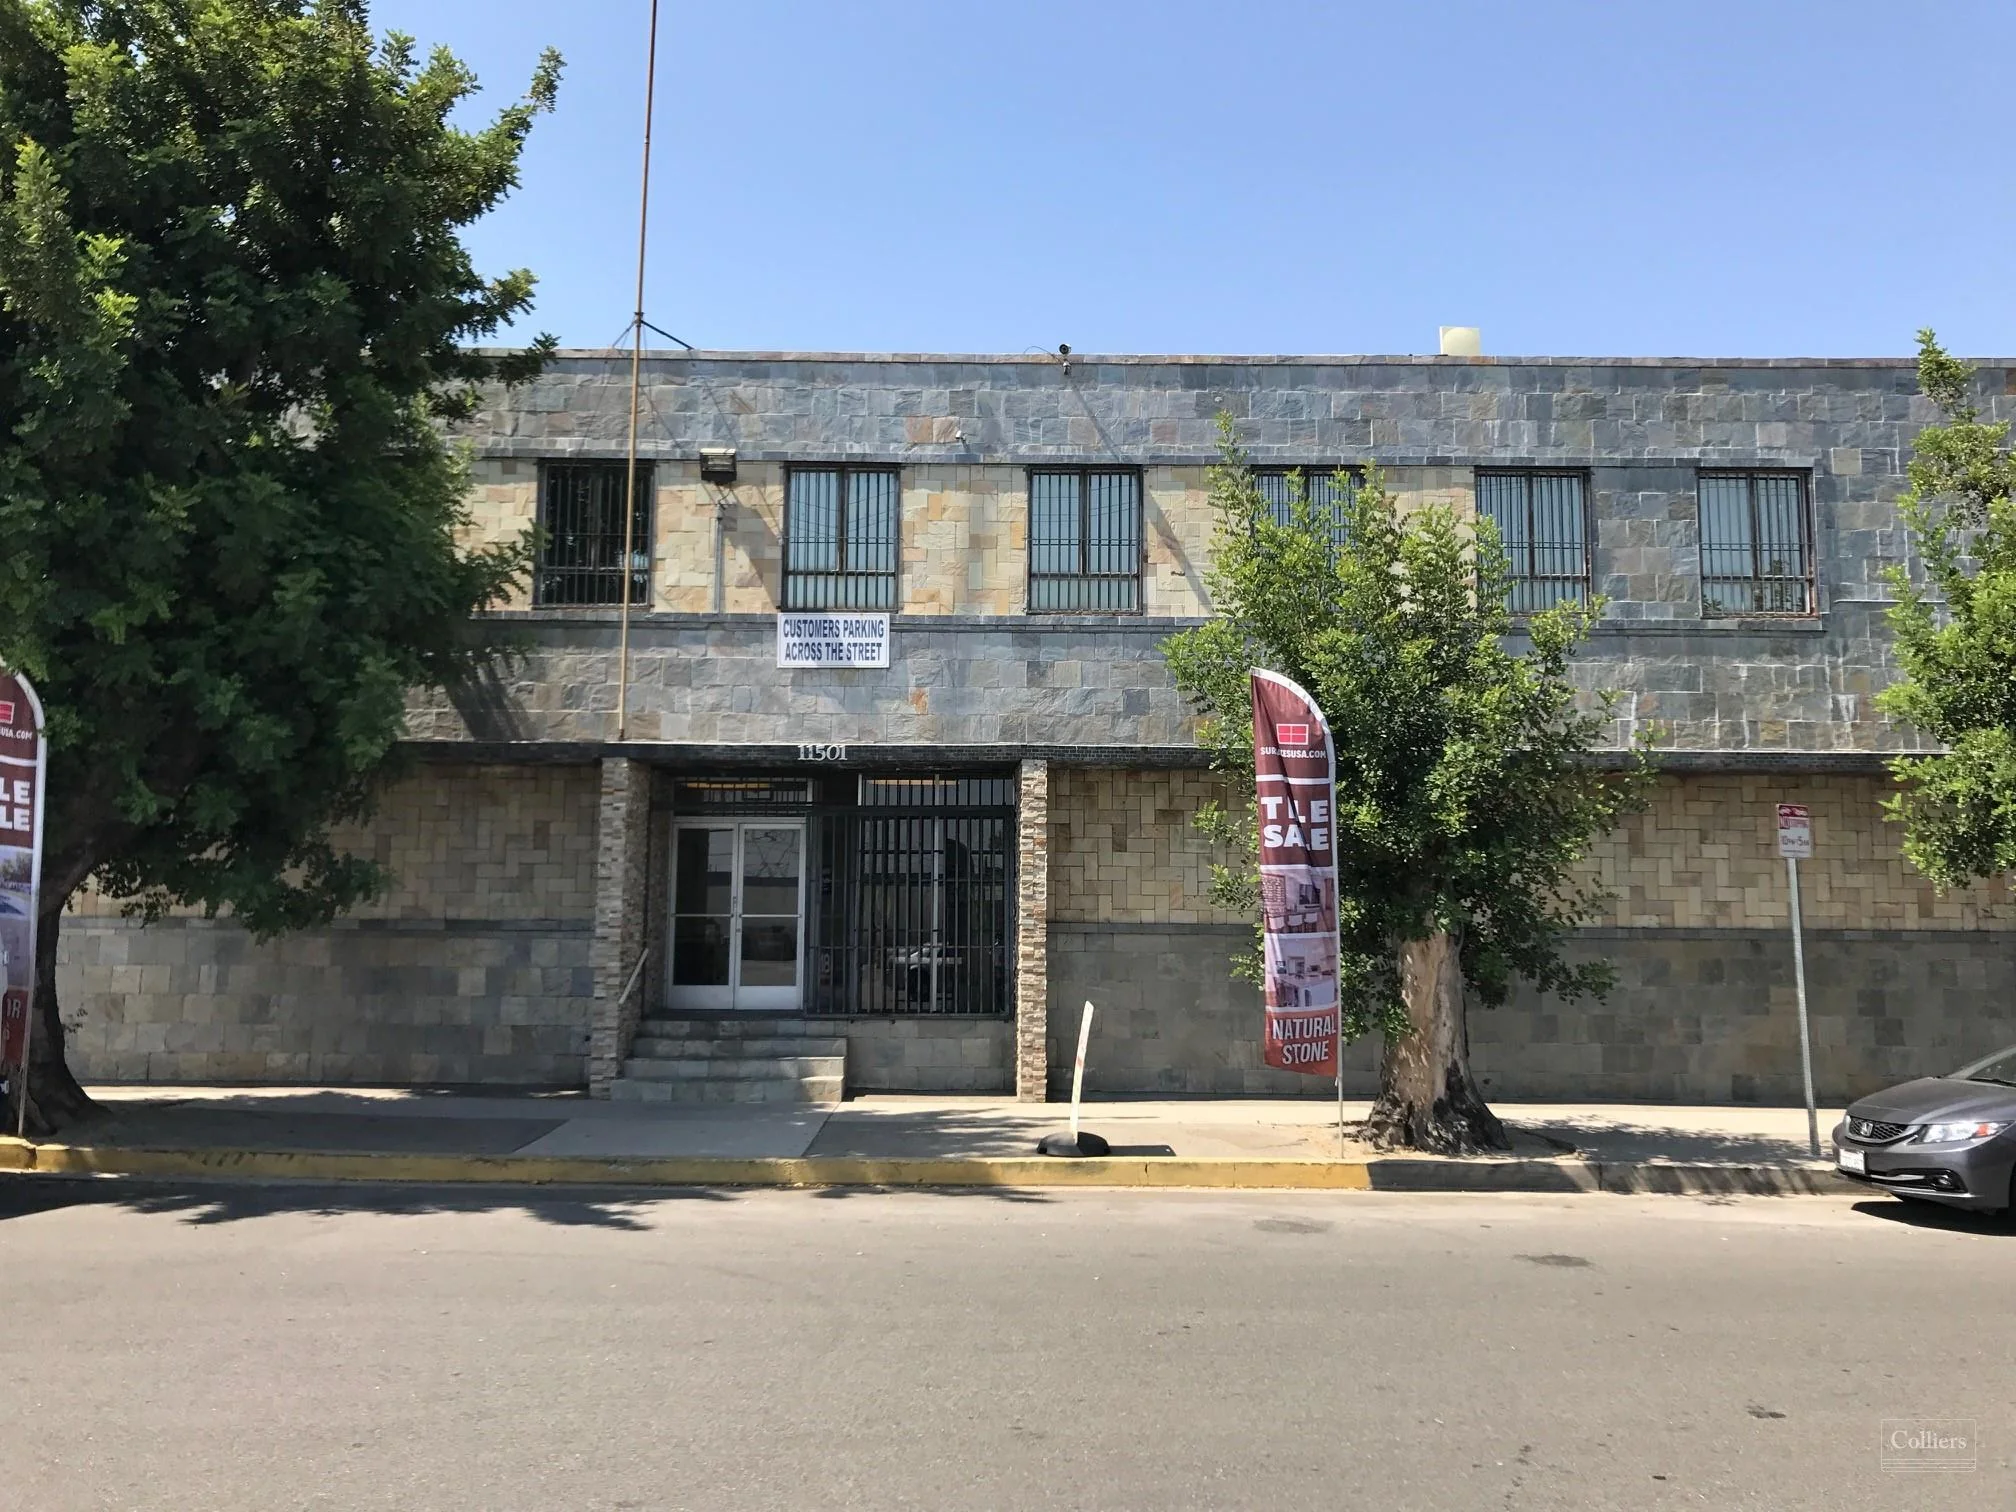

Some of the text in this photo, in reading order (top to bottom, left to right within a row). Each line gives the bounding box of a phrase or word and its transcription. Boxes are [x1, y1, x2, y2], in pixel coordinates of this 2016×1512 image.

[783, 619, 884, 638] CUSTOMERS PARKING
[785, 642, 882, 661] ACROSS THE STREET
[0, 728, 33, 740] USA.COM
[797, 745, 848, 761] 11501
[1263, 824, 1329, 851] SAE
[1272, 1013, 1337, 1041] NATURAL
[1282, 1041, 1329, 1065] STONE
